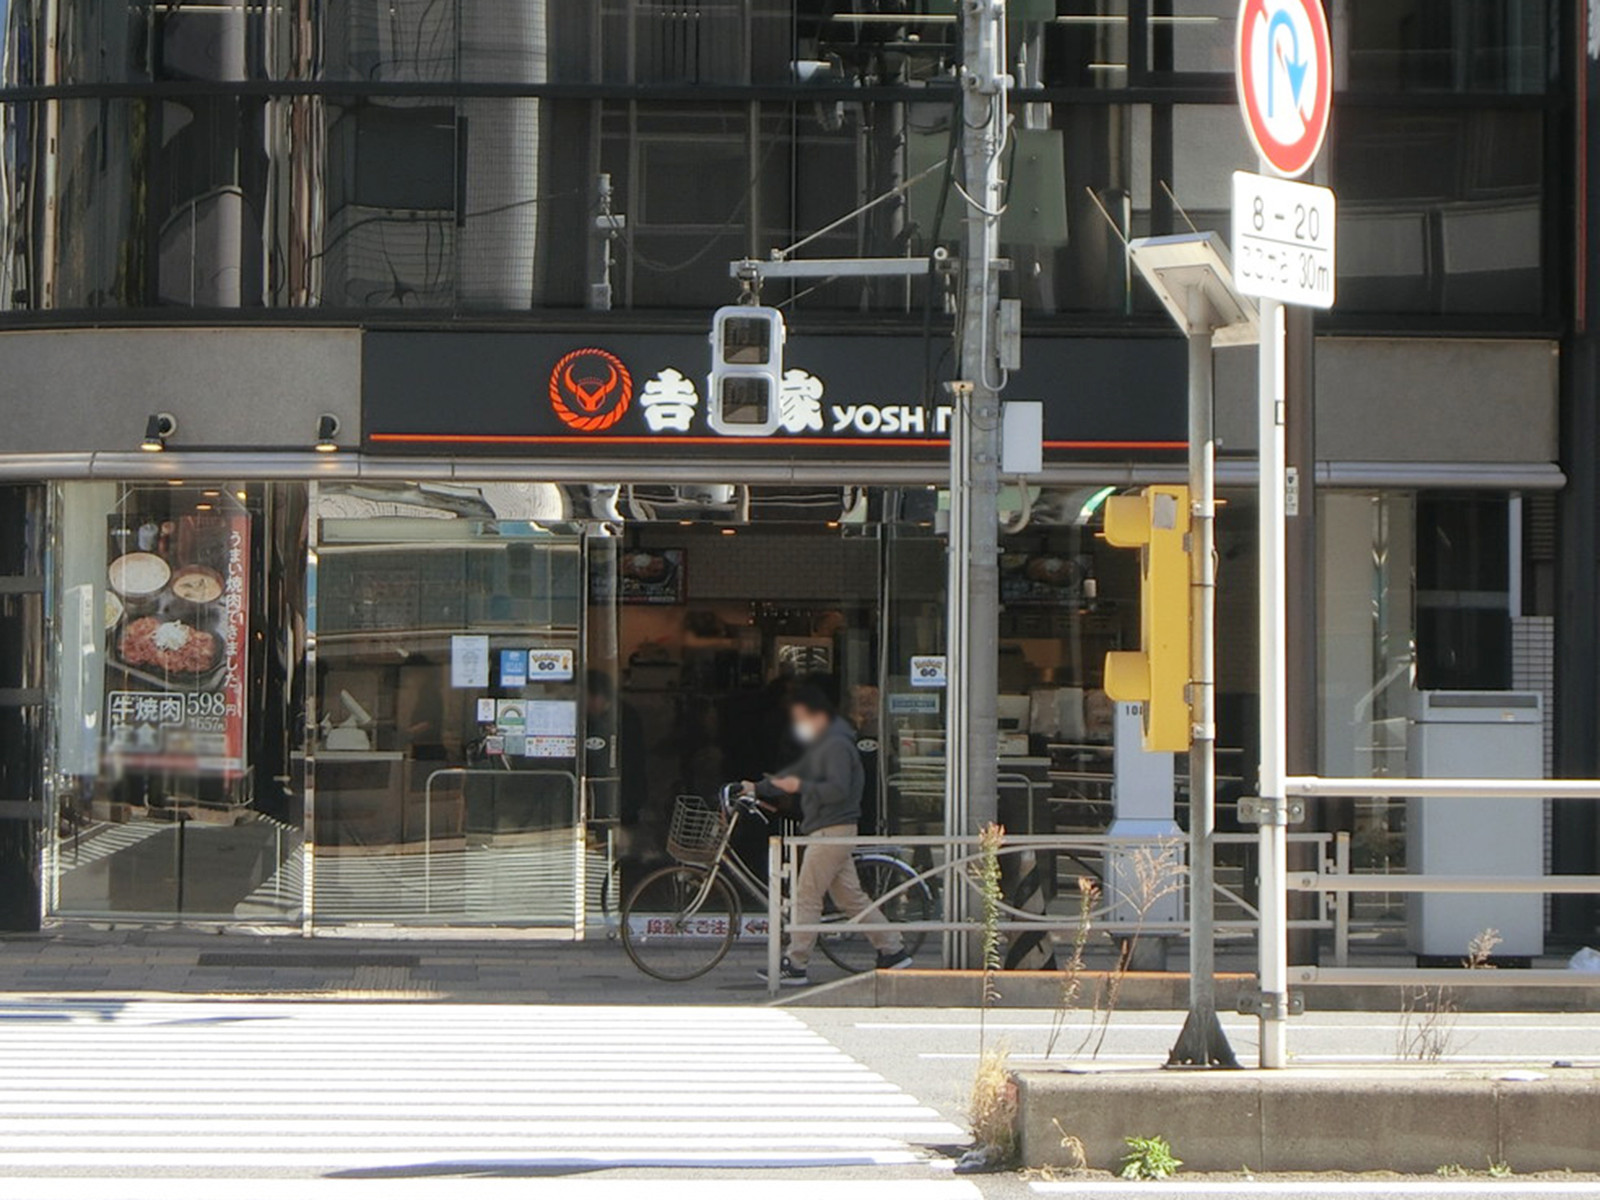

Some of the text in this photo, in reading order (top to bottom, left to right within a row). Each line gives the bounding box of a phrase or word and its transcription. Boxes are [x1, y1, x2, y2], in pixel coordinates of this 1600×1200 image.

[1299, 251, 1329, 292] 30m
[640, 367, 824, 433] 吉家
[538, 661, 556, 671] GO
[111, 695, 181, 721] 牛焼肉
